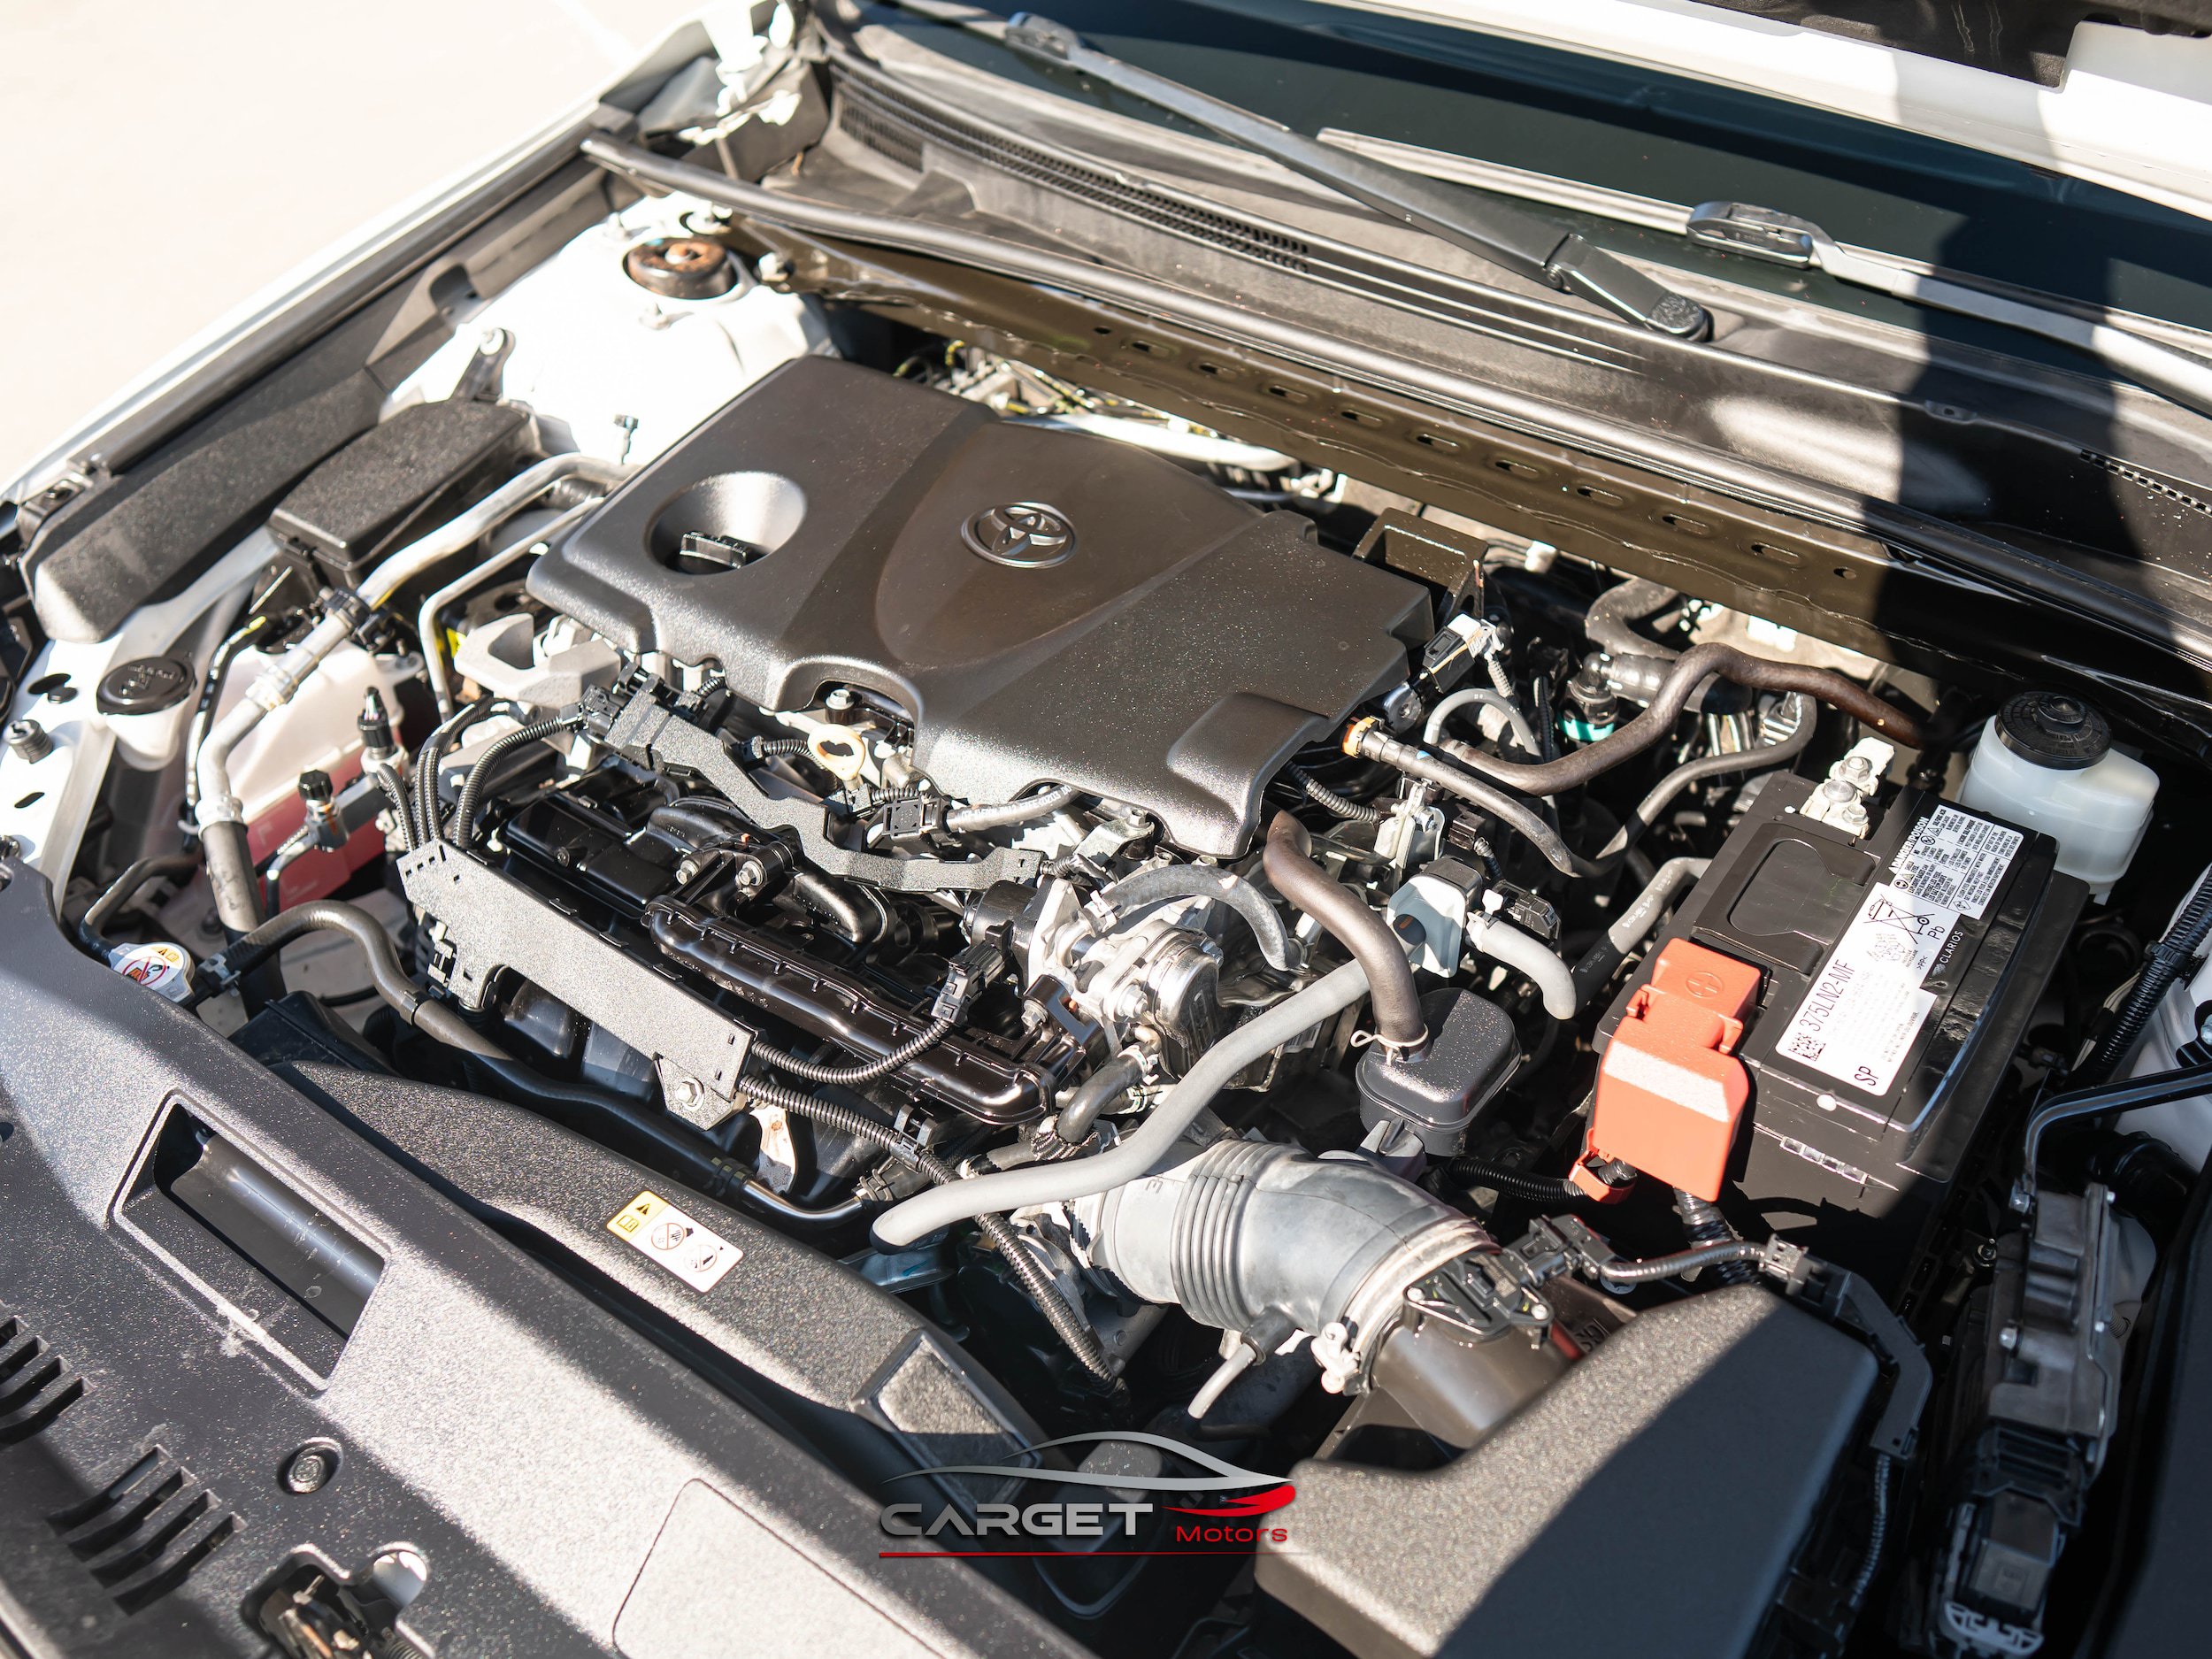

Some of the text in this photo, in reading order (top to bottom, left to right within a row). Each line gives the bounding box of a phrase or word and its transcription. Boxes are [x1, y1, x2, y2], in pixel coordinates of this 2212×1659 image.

[1894, 816, 1930, 870] DANGER/POISON
[1927, 926, 1947, 941] Pb
[1940, 930, 1964, 964] CLARIOS
[1799, 959, 1855, 1032] 375LN2-MF
[1854, 1065, 1879, 1087] SP
